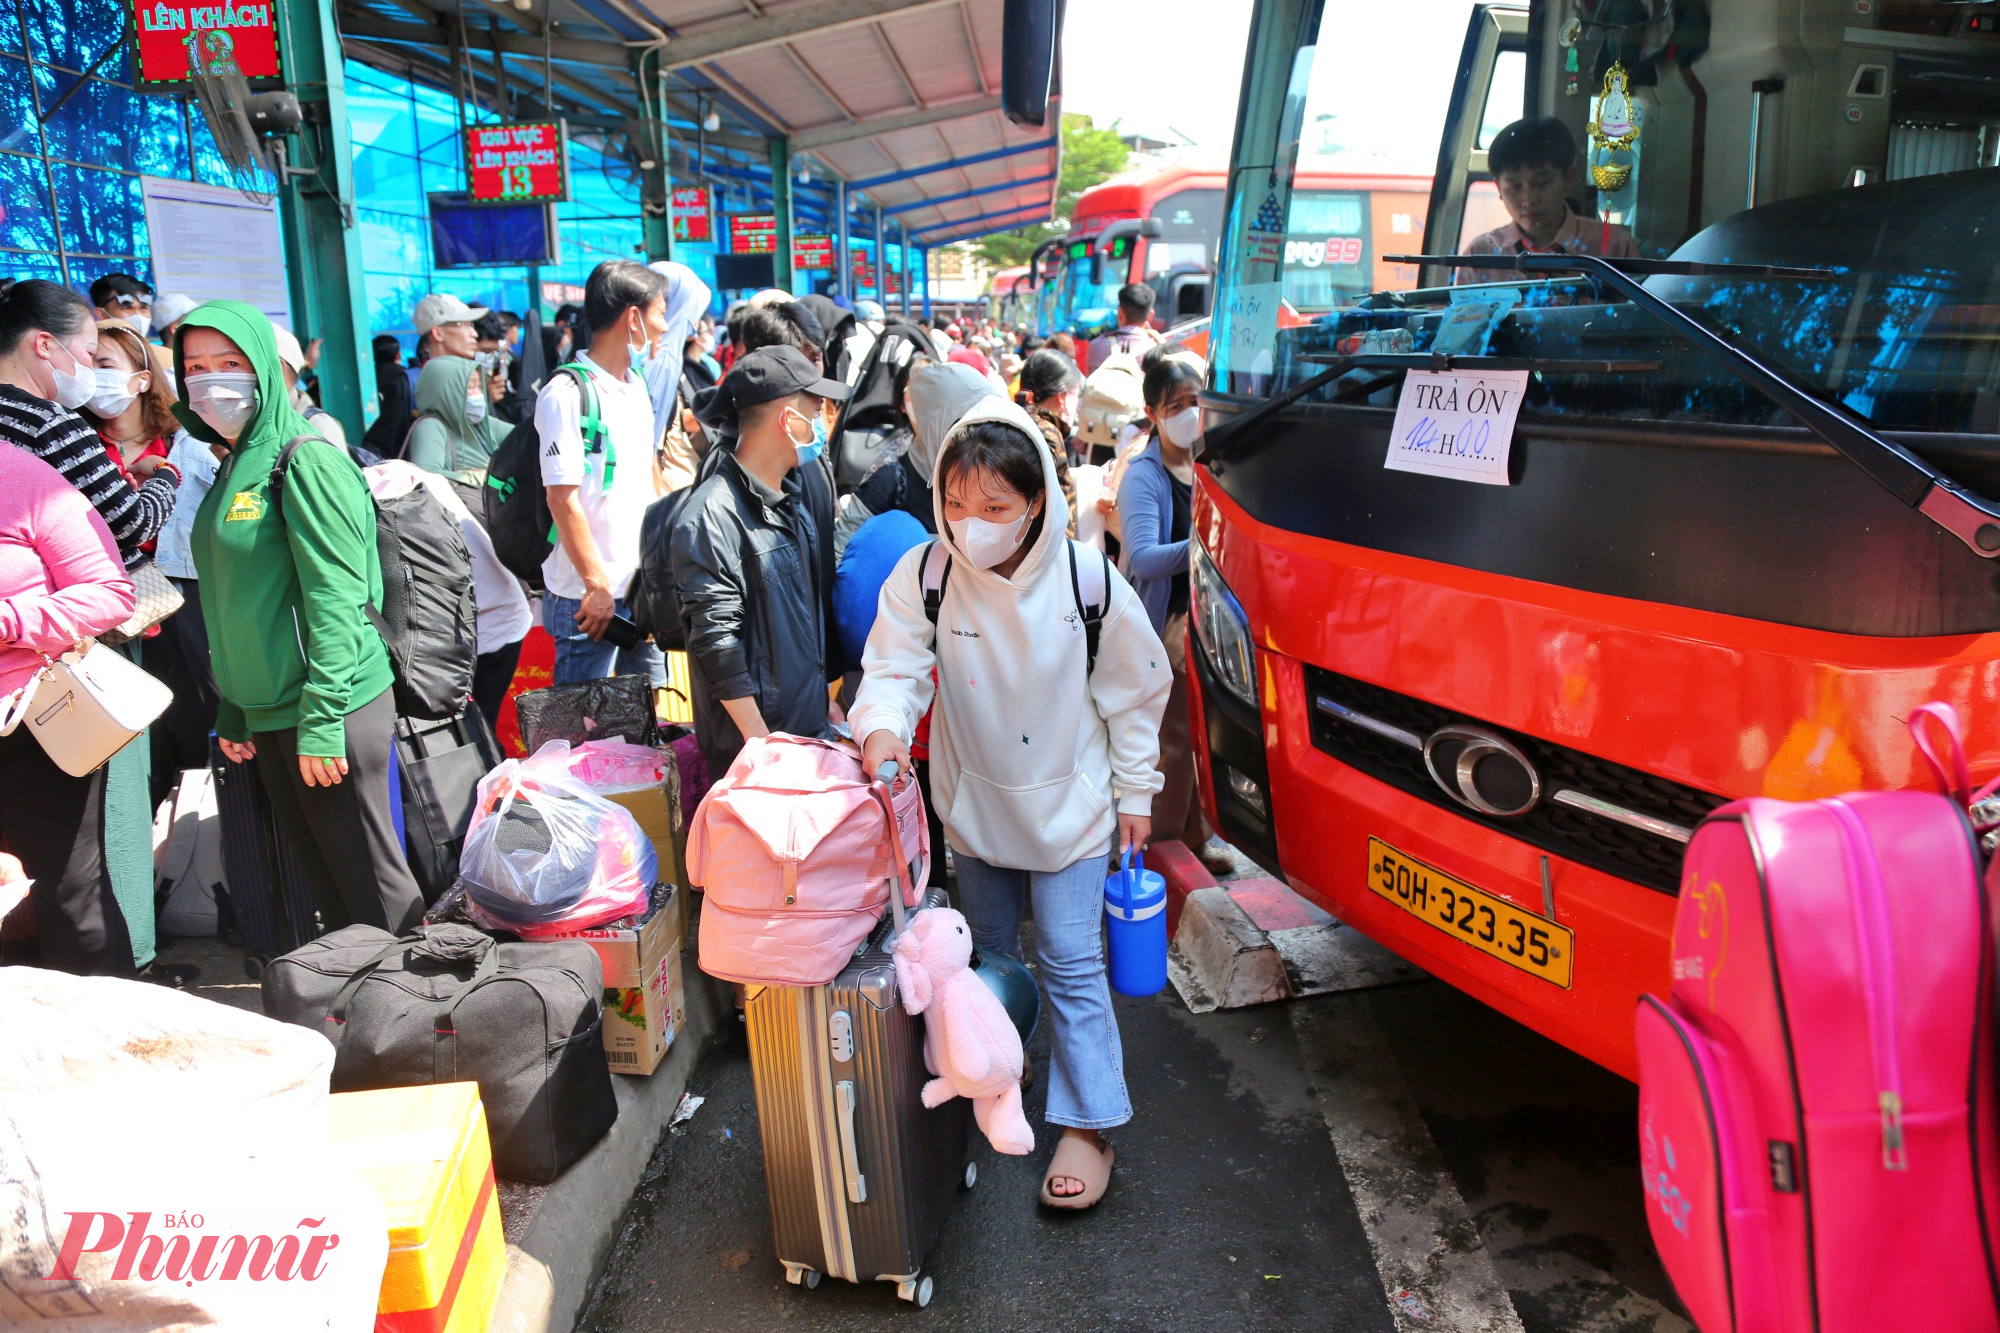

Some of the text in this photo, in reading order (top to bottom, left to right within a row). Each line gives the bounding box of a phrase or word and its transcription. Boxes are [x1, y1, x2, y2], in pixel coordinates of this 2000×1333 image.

[142, 0, 269, 31] LÊN KHÁCH
[480, 127, 544, 148] KHU VỰC
[475, 147, 555, 168] LÊN KHÁCH
[498, 166, 534, 197] 13
[675, 216, 689, 239] 4
[1416, 379, 1509, 415] TRÀ ÔN
[1382, 854, 1550, 967] 50H-323.35
